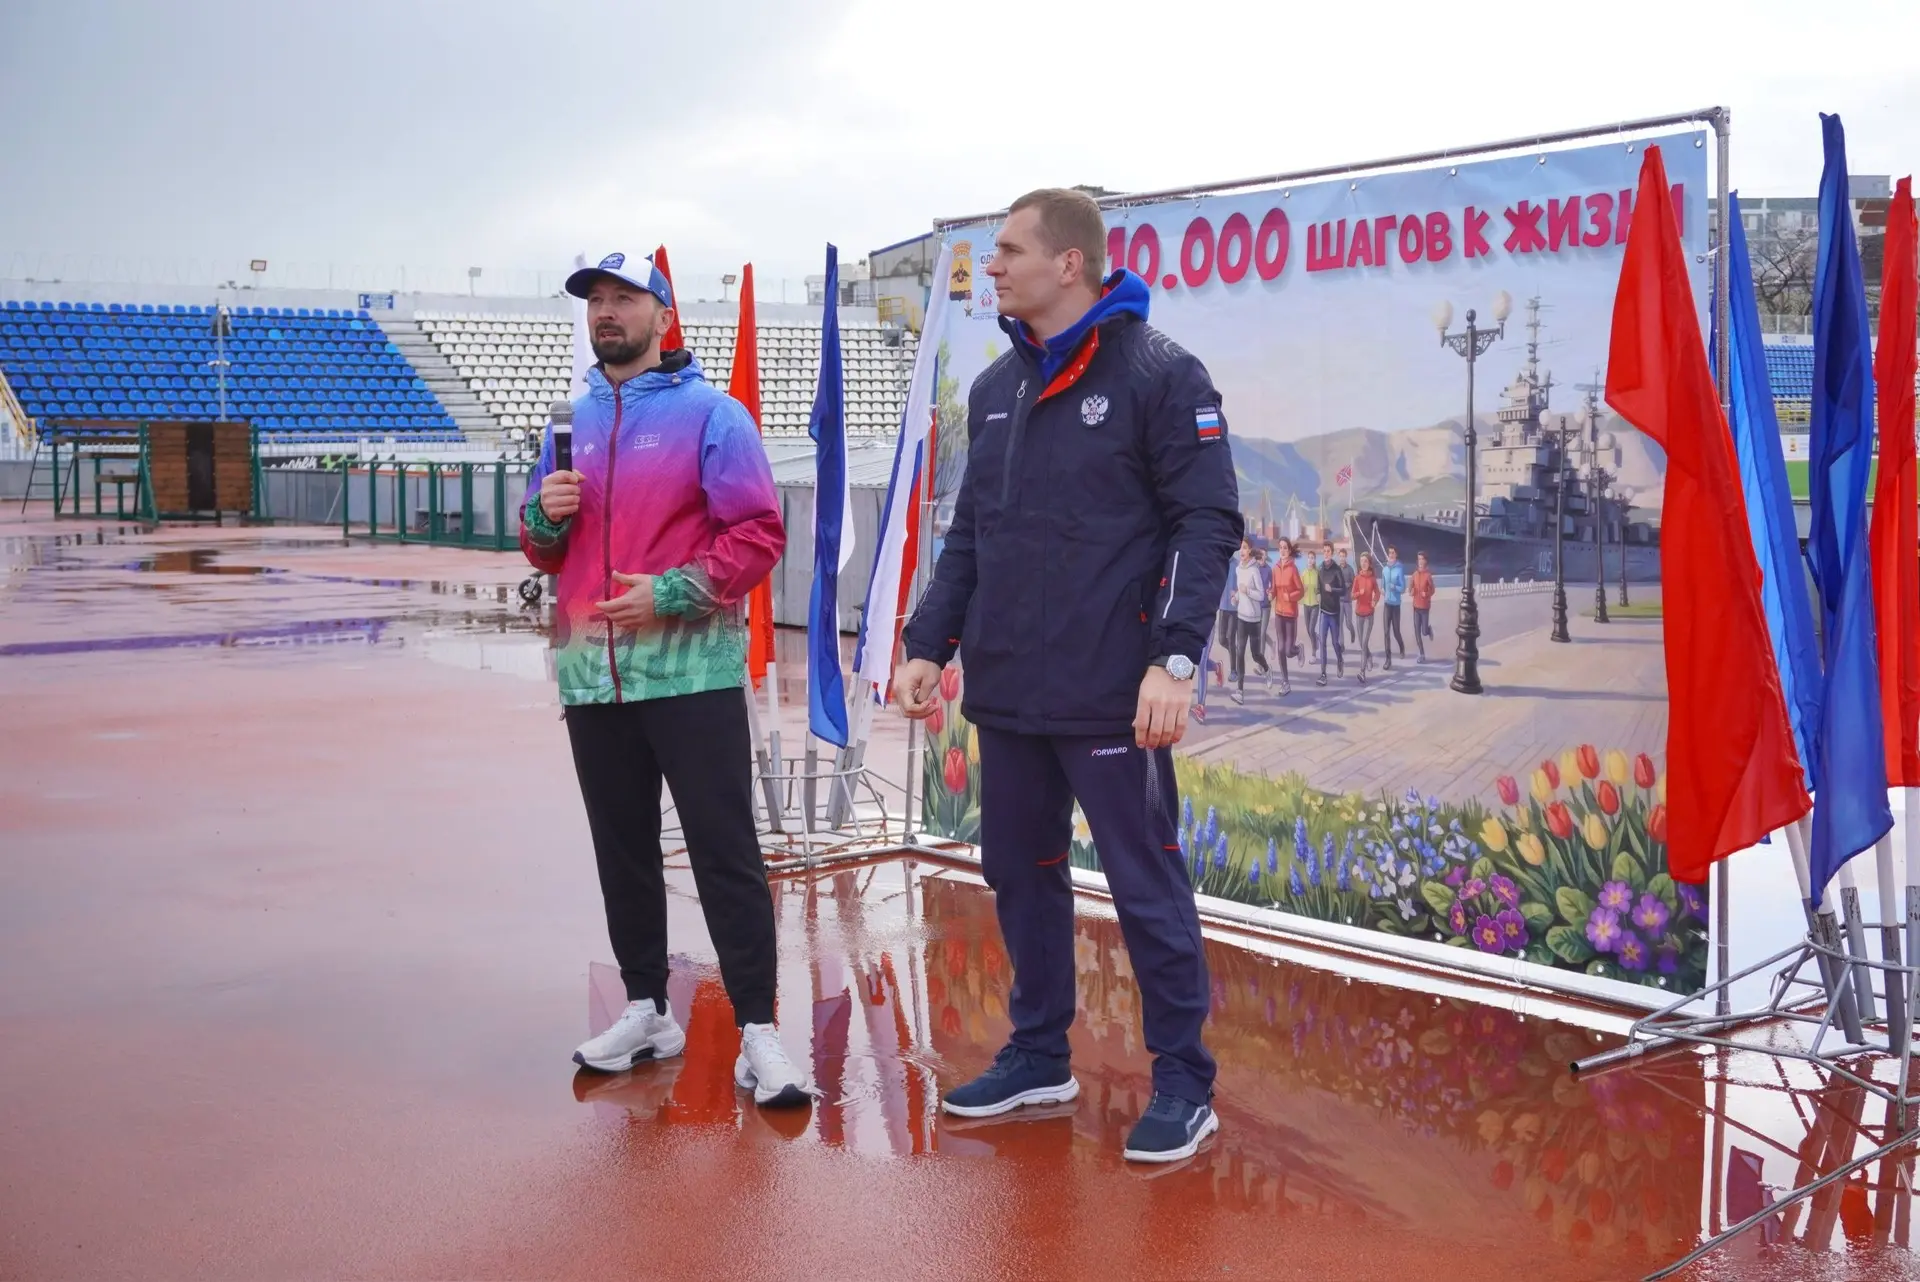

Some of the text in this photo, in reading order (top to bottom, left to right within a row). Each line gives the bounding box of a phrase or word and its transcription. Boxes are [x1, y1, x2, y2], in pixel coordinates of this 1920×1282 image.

[1106, 183, 1684, 288] 10.000 ШАГОВ К ЖИЗН
[1091, 746, 1128, 757] FORWARD
